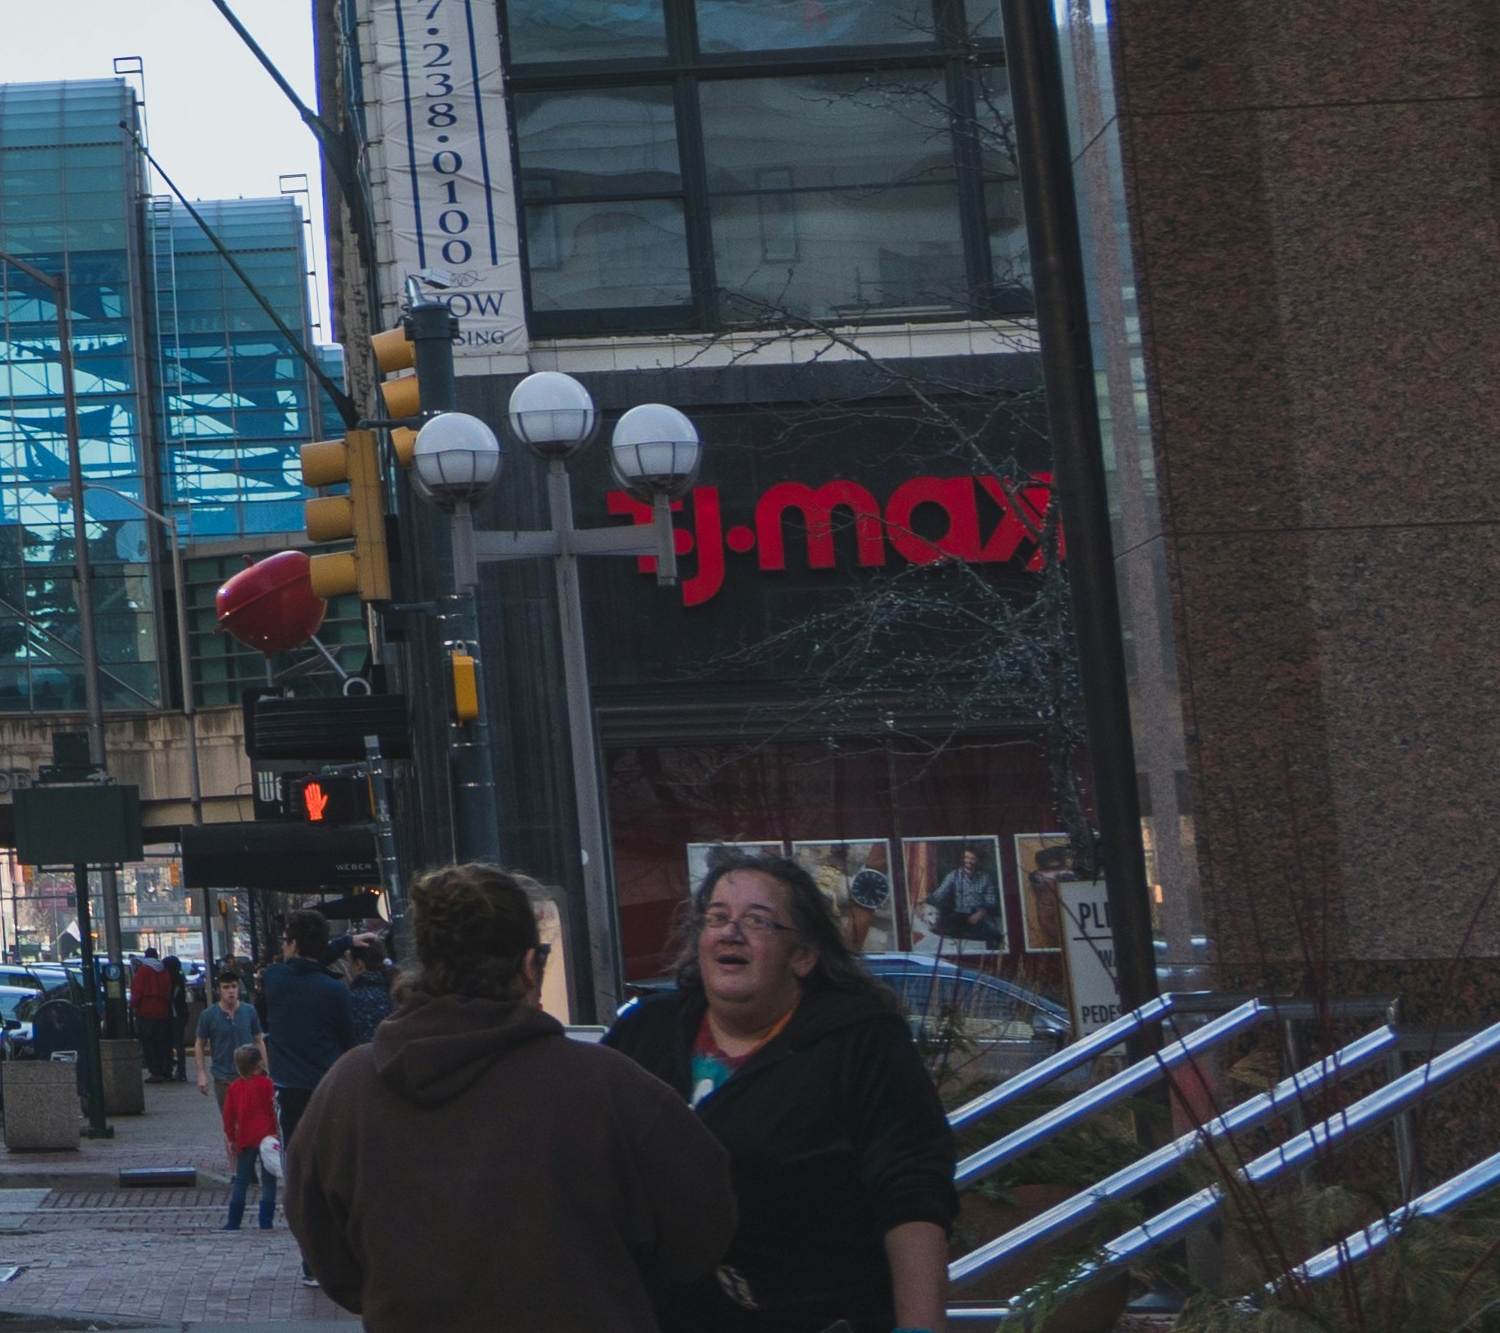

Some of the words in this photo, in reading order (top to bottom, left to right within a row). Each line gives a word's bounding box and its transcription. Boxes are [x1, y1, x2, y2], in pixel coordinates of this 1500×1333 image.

[436, 292, 504, 318] OW
[451, 330, 504, 347] SING
[257, 771, 284, 802] We
